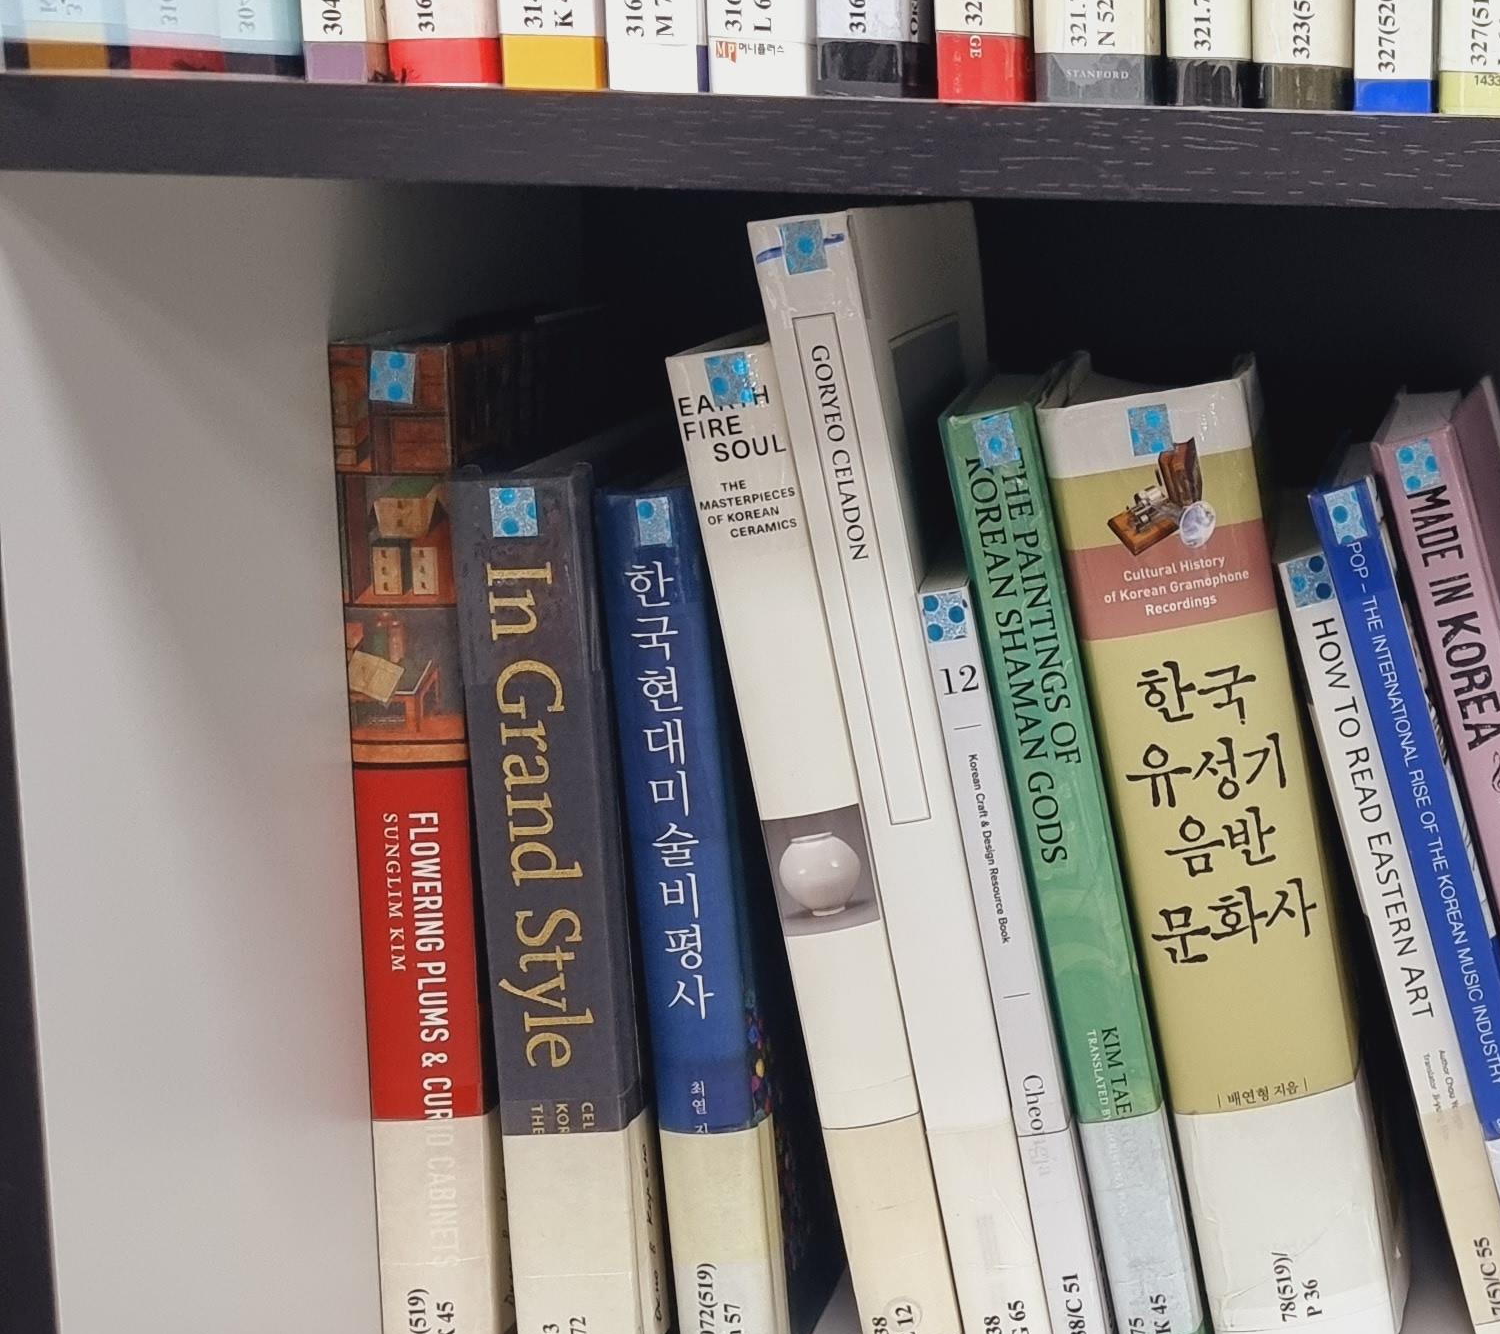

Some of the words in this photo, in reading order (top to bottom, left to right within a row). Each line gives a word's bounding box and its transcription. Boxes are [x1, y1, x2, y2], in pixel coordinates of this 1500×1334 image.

[811, 344, 845, 442] GORYEO
[720, 479, 747, 492] THE
[727, 506, 780, 524] KOREAN
[730, 519, 798, 539] CERAMICS
[1406, 484, 1464, 567] MADE
[486, 561, 552, 641] In
[1119, 581, 1167, 601] Korean
[1170, 569, 1250, 593] Gramophone
[1123, 563, 1178, 582] Cultural
[1179, 555, 1225, 574] History
[1014, 529, 1071, 713] PAINTINGS
[1311, 617, 1350, 689] HOW
[940, 665, 979, 695] 12
[1136, 660, 1256, 725] 한국
[996, 611, 1048, 760] SHAMAN
[1027, 770, 1068, 865] GODS
[1335, 696, 1361, 738] TO
[496, 659, 584, 887] Grand
[1125, 732, 1287, 808] 유성기
[1345, 747, 1383, 824] READ
[1372, 635, 1419, 767] INTERNATIONAL
[1420, 811, 1439, 836] OF
[1437, 874, 1468, 944] KOREAN
[383, 813, 403, 918] SUNGLIM
[968, 753, 982, 790] Korean
[980, 830, 995, 865] Design
[989, 868, 1004, 915] Resource
[1164, 806, 1277, 877] 음반
[408, 812, 445, 953] FLOWERING
[1367, 830, 1418, 958] EASTERN
[389, 927, 406, 971] KIM
[1151, 877, 1317, 964] 문화사
[498, 909, 594, 1068] Style
[1400, 965, 1435, 1019] ART
[1228, 1086, 1270, 1106] 배연형
[1474, 1237, 1493, 1255] 55
[437, 1302, 455, 1321] 45
[1008, 1300, 1026, 1320] 65
[1303, 1278, 1320, 1300] 36
